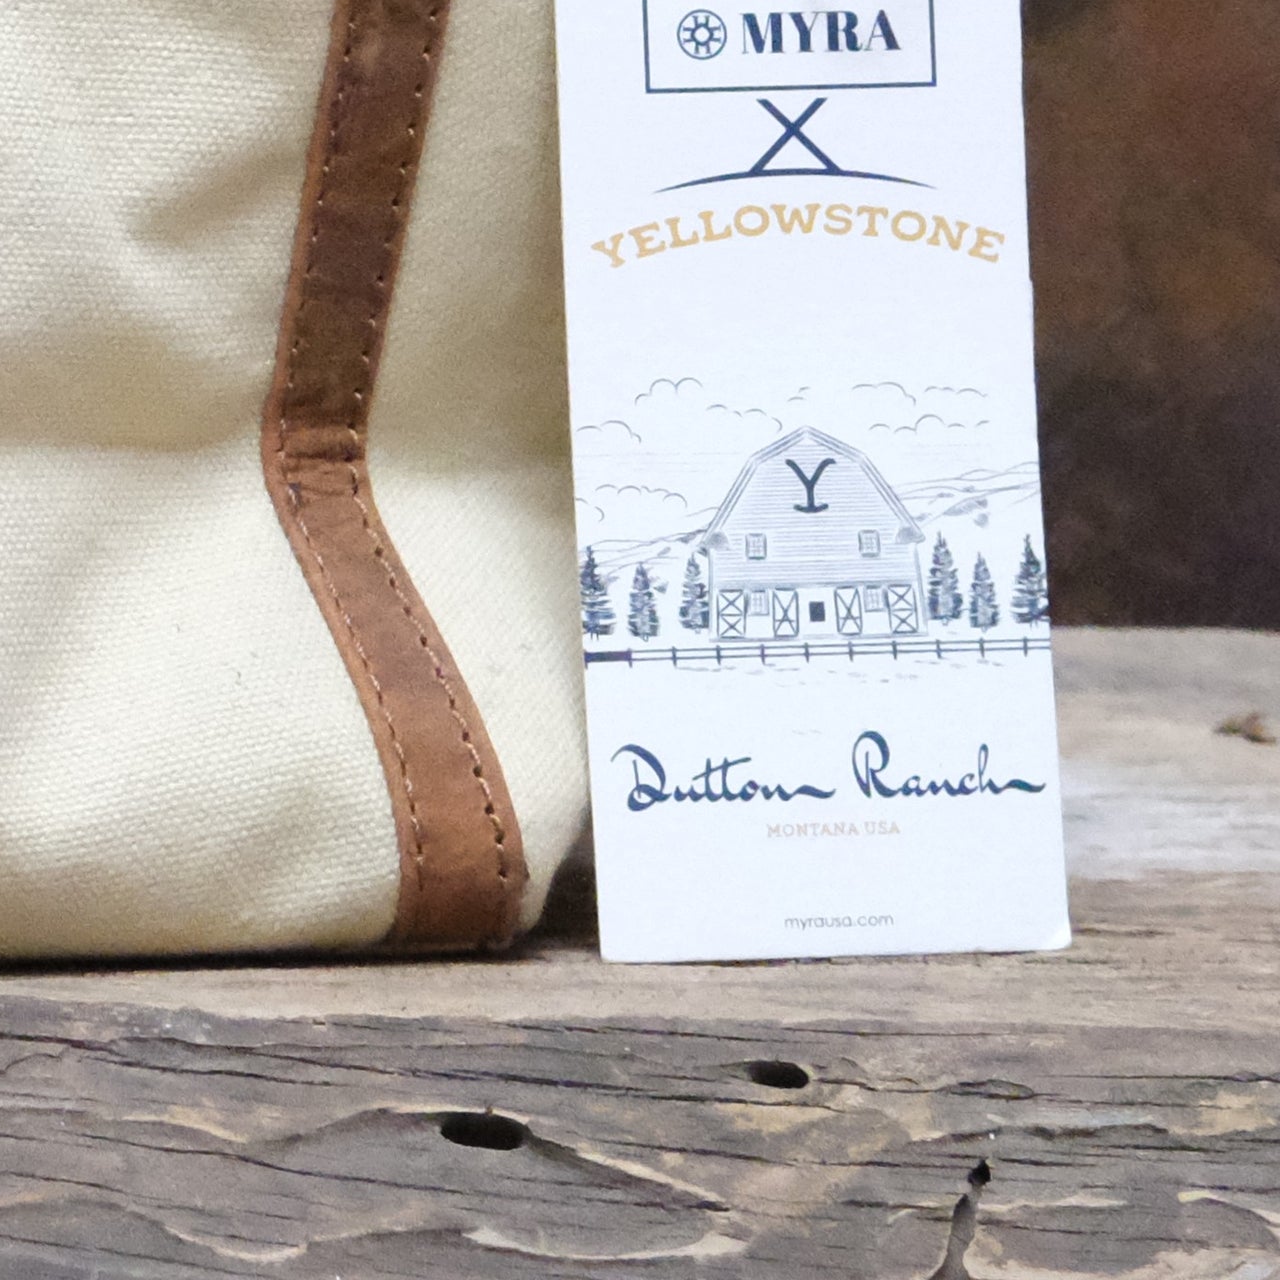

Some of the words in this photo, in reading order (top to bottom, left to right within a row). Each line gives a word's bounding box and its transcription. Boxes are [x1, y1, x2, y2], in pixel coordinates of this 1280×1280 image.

[740, 9, 902, 55] MYRA
[590, 203, 1006, 269] YELLOWSTONE
[610, 743, 836, 812] Dutton
[851, 730, 1047, 799] Ranch
[766, 822, 860, 838] MONTANA
[863, 820, 901, 835] USA
[784, 914, 894, 931] myrausa.com
